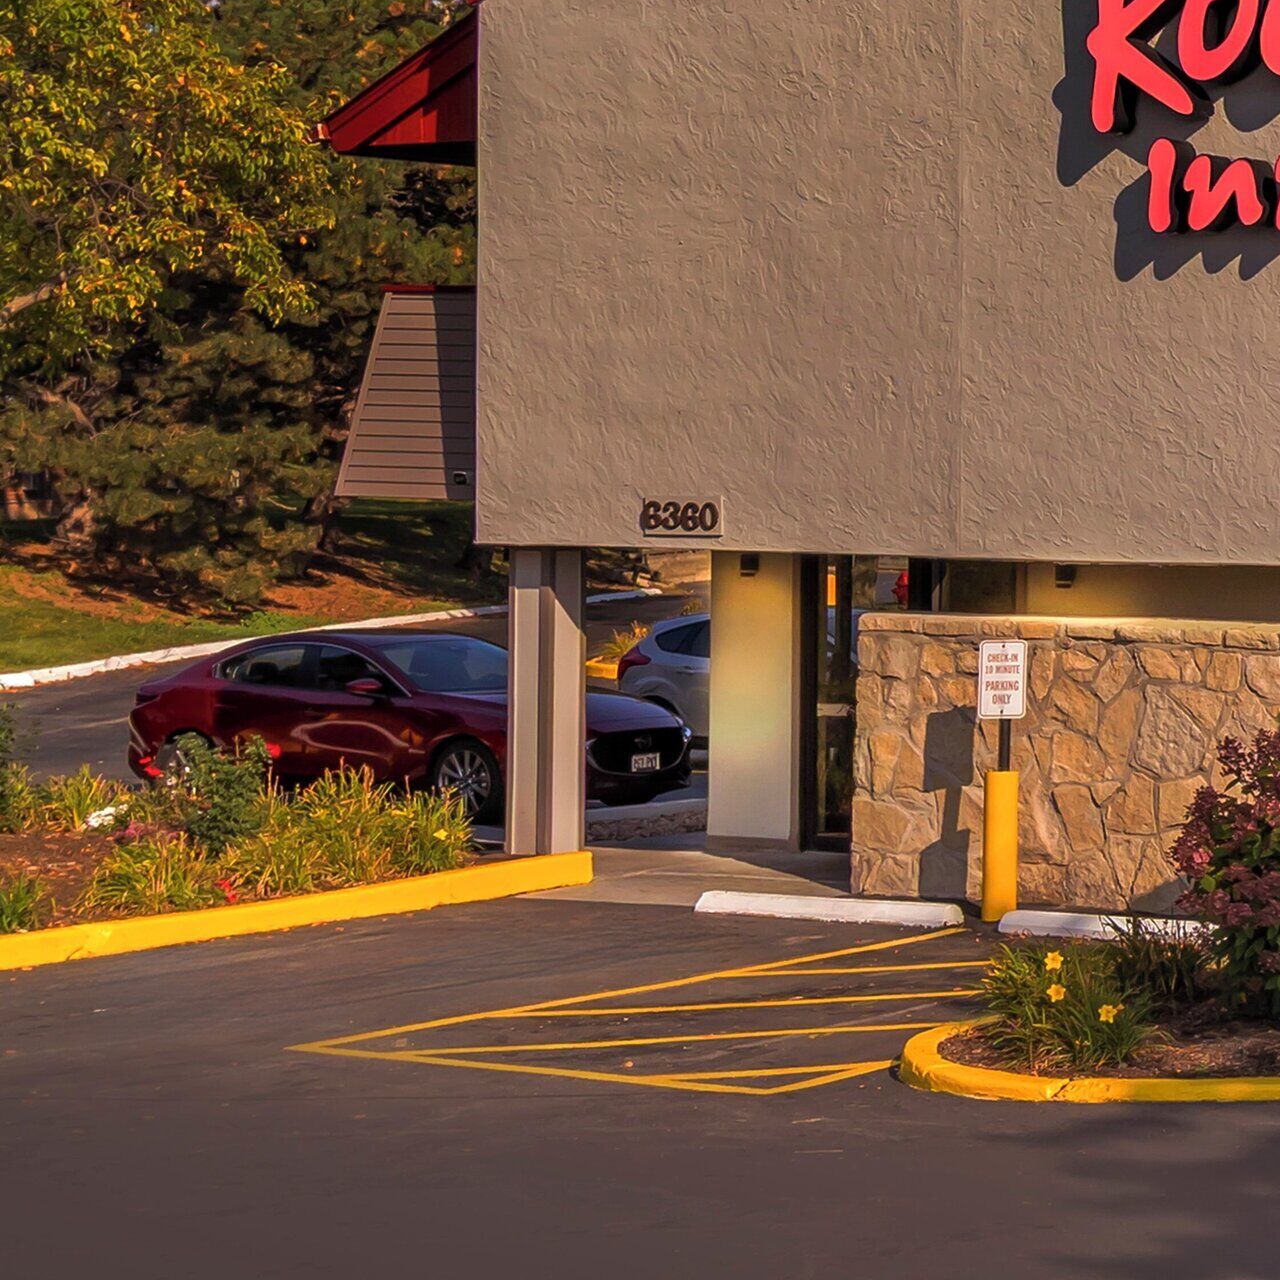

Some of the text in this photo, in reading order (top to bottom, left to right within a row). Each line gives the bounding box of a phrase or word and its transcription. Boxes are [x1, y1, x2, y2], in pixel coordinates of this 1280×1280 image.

[640, 500, 720, 532] 6360
[987, 653, 1019, 663] CHECK-IN
[985, 665, 1020, 675] 10 MINUTE
[985, 680, 1020, 692] PARKING
[992, 694, 1012, 705] ONLY
